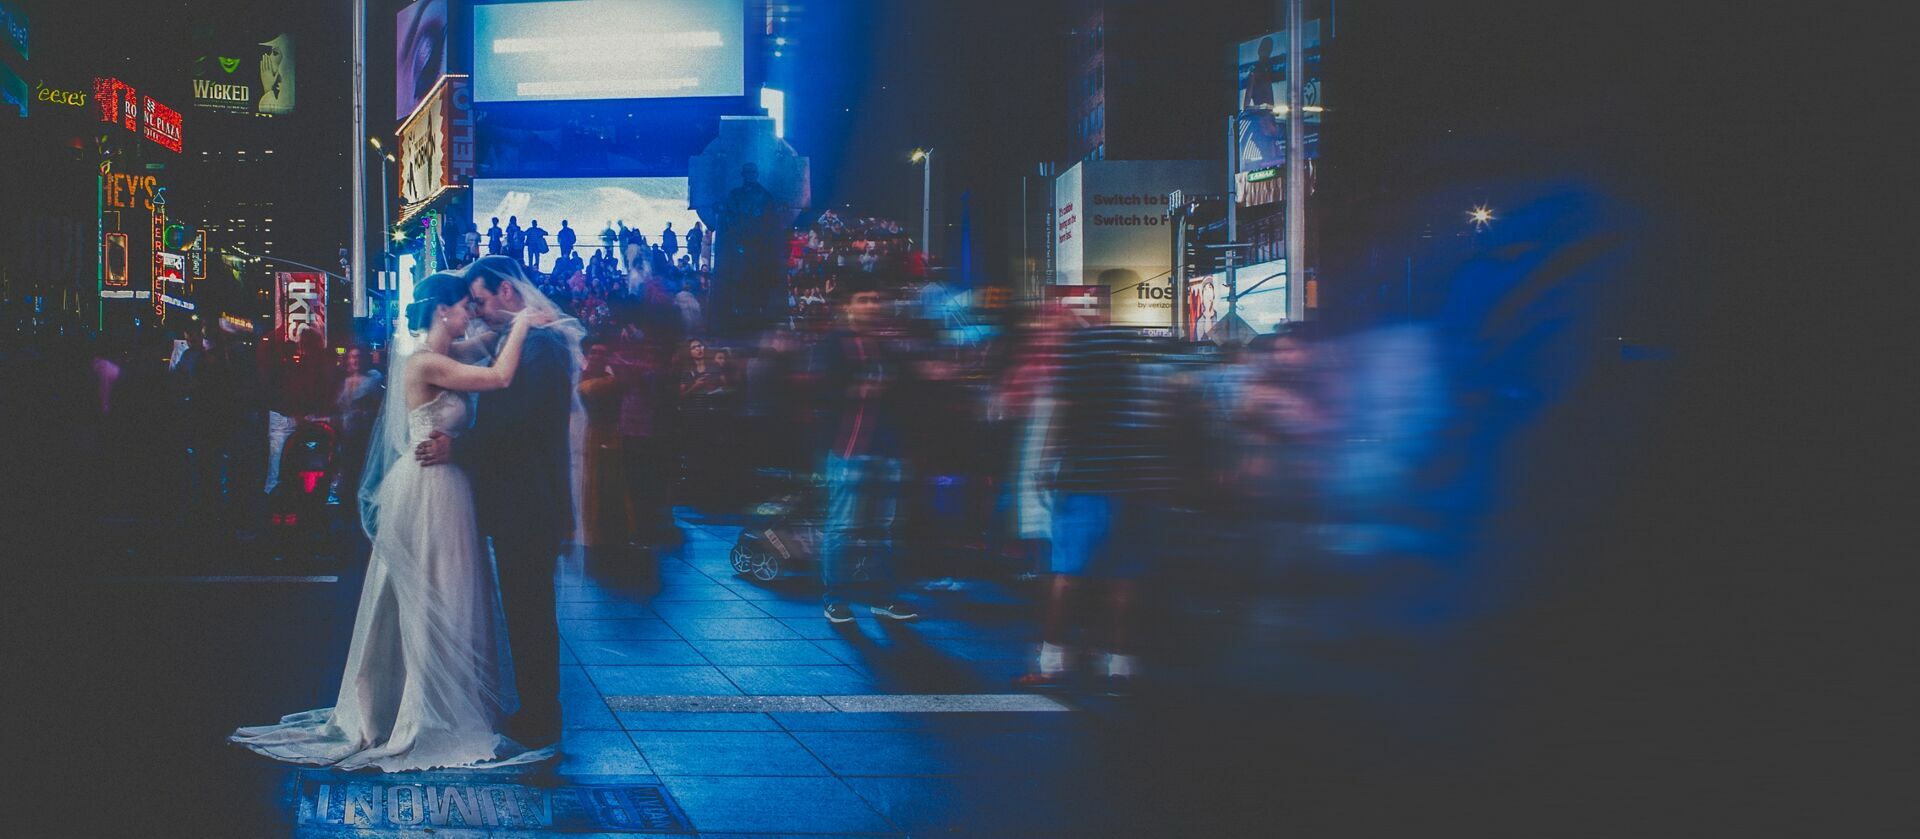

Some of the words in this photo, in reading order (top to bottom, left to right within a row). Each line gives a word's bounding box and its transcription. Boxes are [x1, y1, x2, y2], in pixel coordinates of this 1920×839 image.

[1094, 194, 1141, 206] Switch
[1143, 194, 1158, 206] to
[1094, 215, 1141, 226] Switch
[1143, 215, 1158, 226] to
[1136, 282, 1173, 299] fios
[288, 279, 318, 342] tkts
[1137, 302, 1146, 310] by
